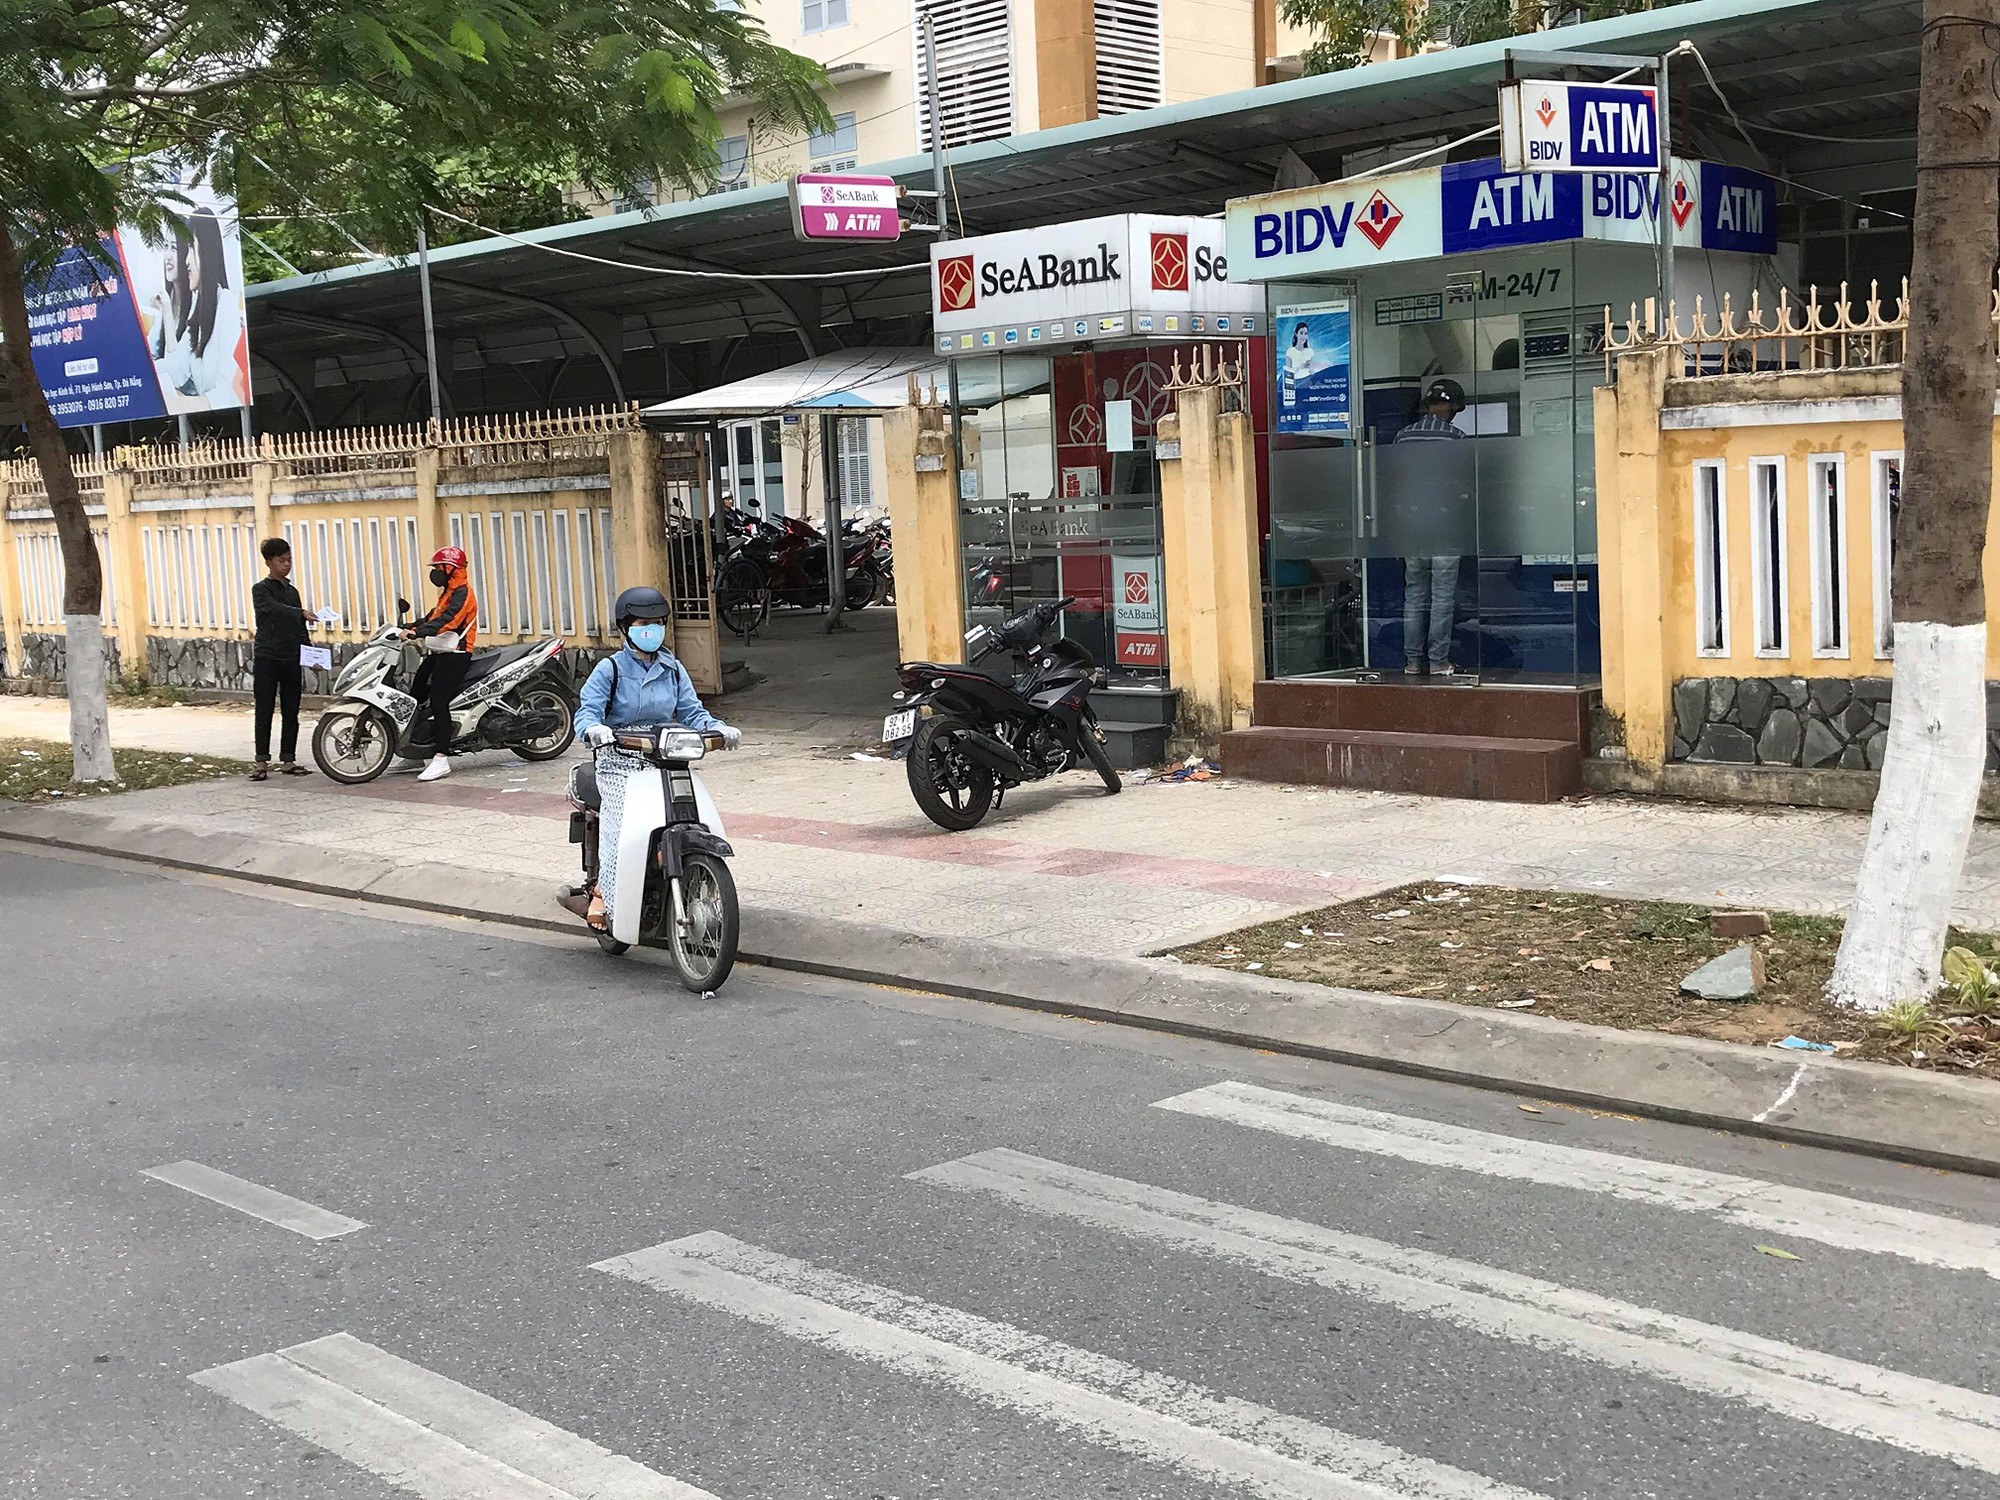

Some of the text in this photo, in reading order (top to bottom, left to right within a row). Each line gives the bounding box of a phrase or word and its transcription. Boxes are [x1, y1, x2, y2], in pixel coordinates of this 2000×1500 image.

[1580, 101, 1651, 154] ATM
[1529, 140, 1563, 160] BIDV
[836, 189, 879, 202] SeABank
[1716, 185, 1763, 234] ATM
[845, 213, 881, 231] ATM
[1254, 174, 1554, 259] BIDV ATM
[981, 243, 1121, 298] SeABank
[1448, 267, 1561, 304] M-24/7
[1117, 608, 1159, 620] SeABank
[1125, 642, 1157, 656] ATM
